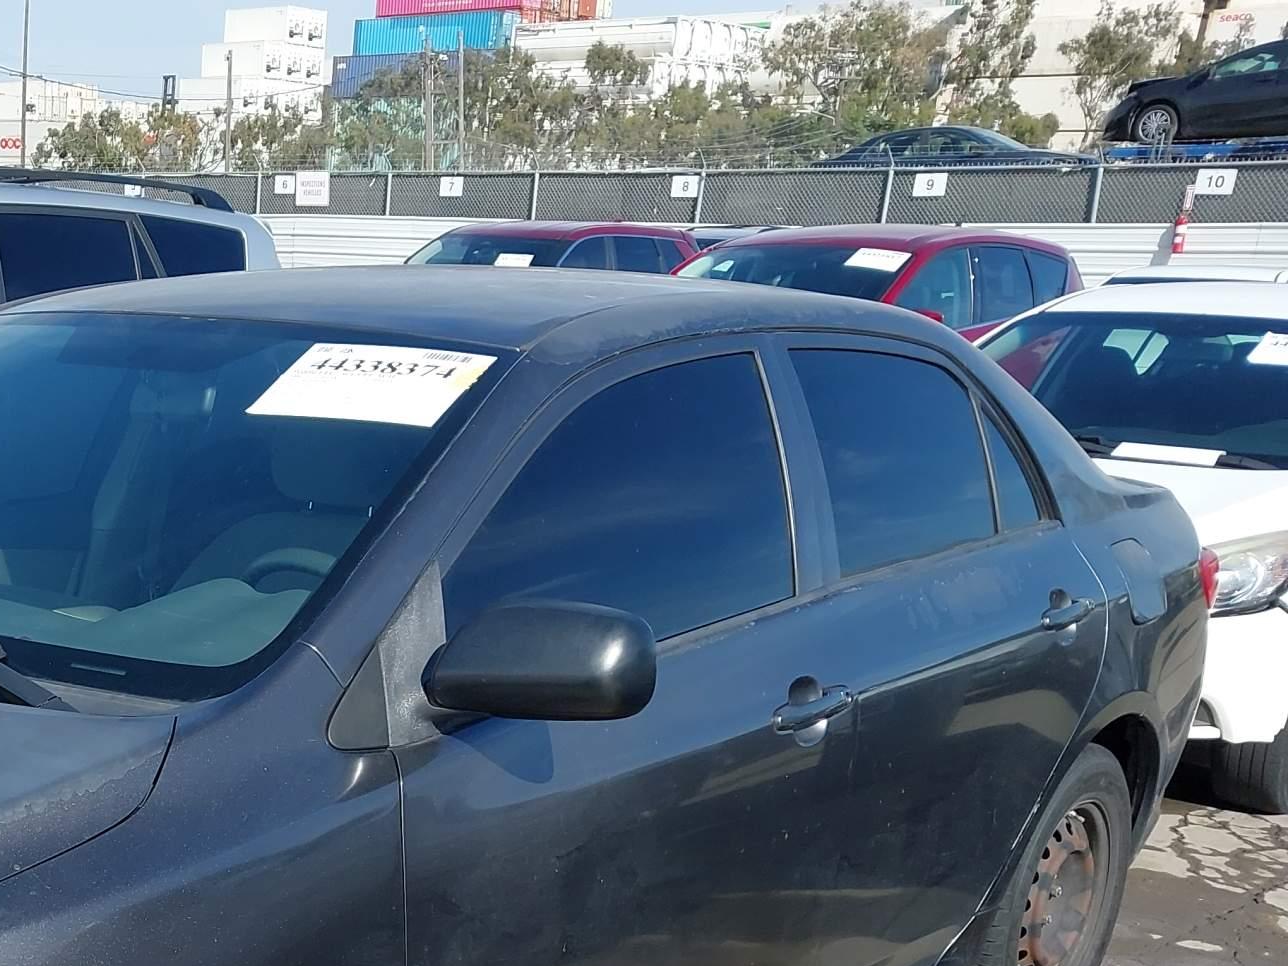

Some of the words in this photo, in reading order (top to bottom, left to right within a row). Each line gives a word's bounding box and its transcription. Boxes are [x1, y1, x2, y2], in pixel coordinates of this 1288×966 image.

[1219, 13, 1252, 22] seaco
[0, 138, 22, 150] OOC
[282, 180, 288, 189] 6
[449, 181, 455, 192] 7
[683, 181, 689, 192] 8
[926, 179, 934, 191] 9
[1206, 175, 1225, 188] 10
[311, 358, 457, 379] 44338374
